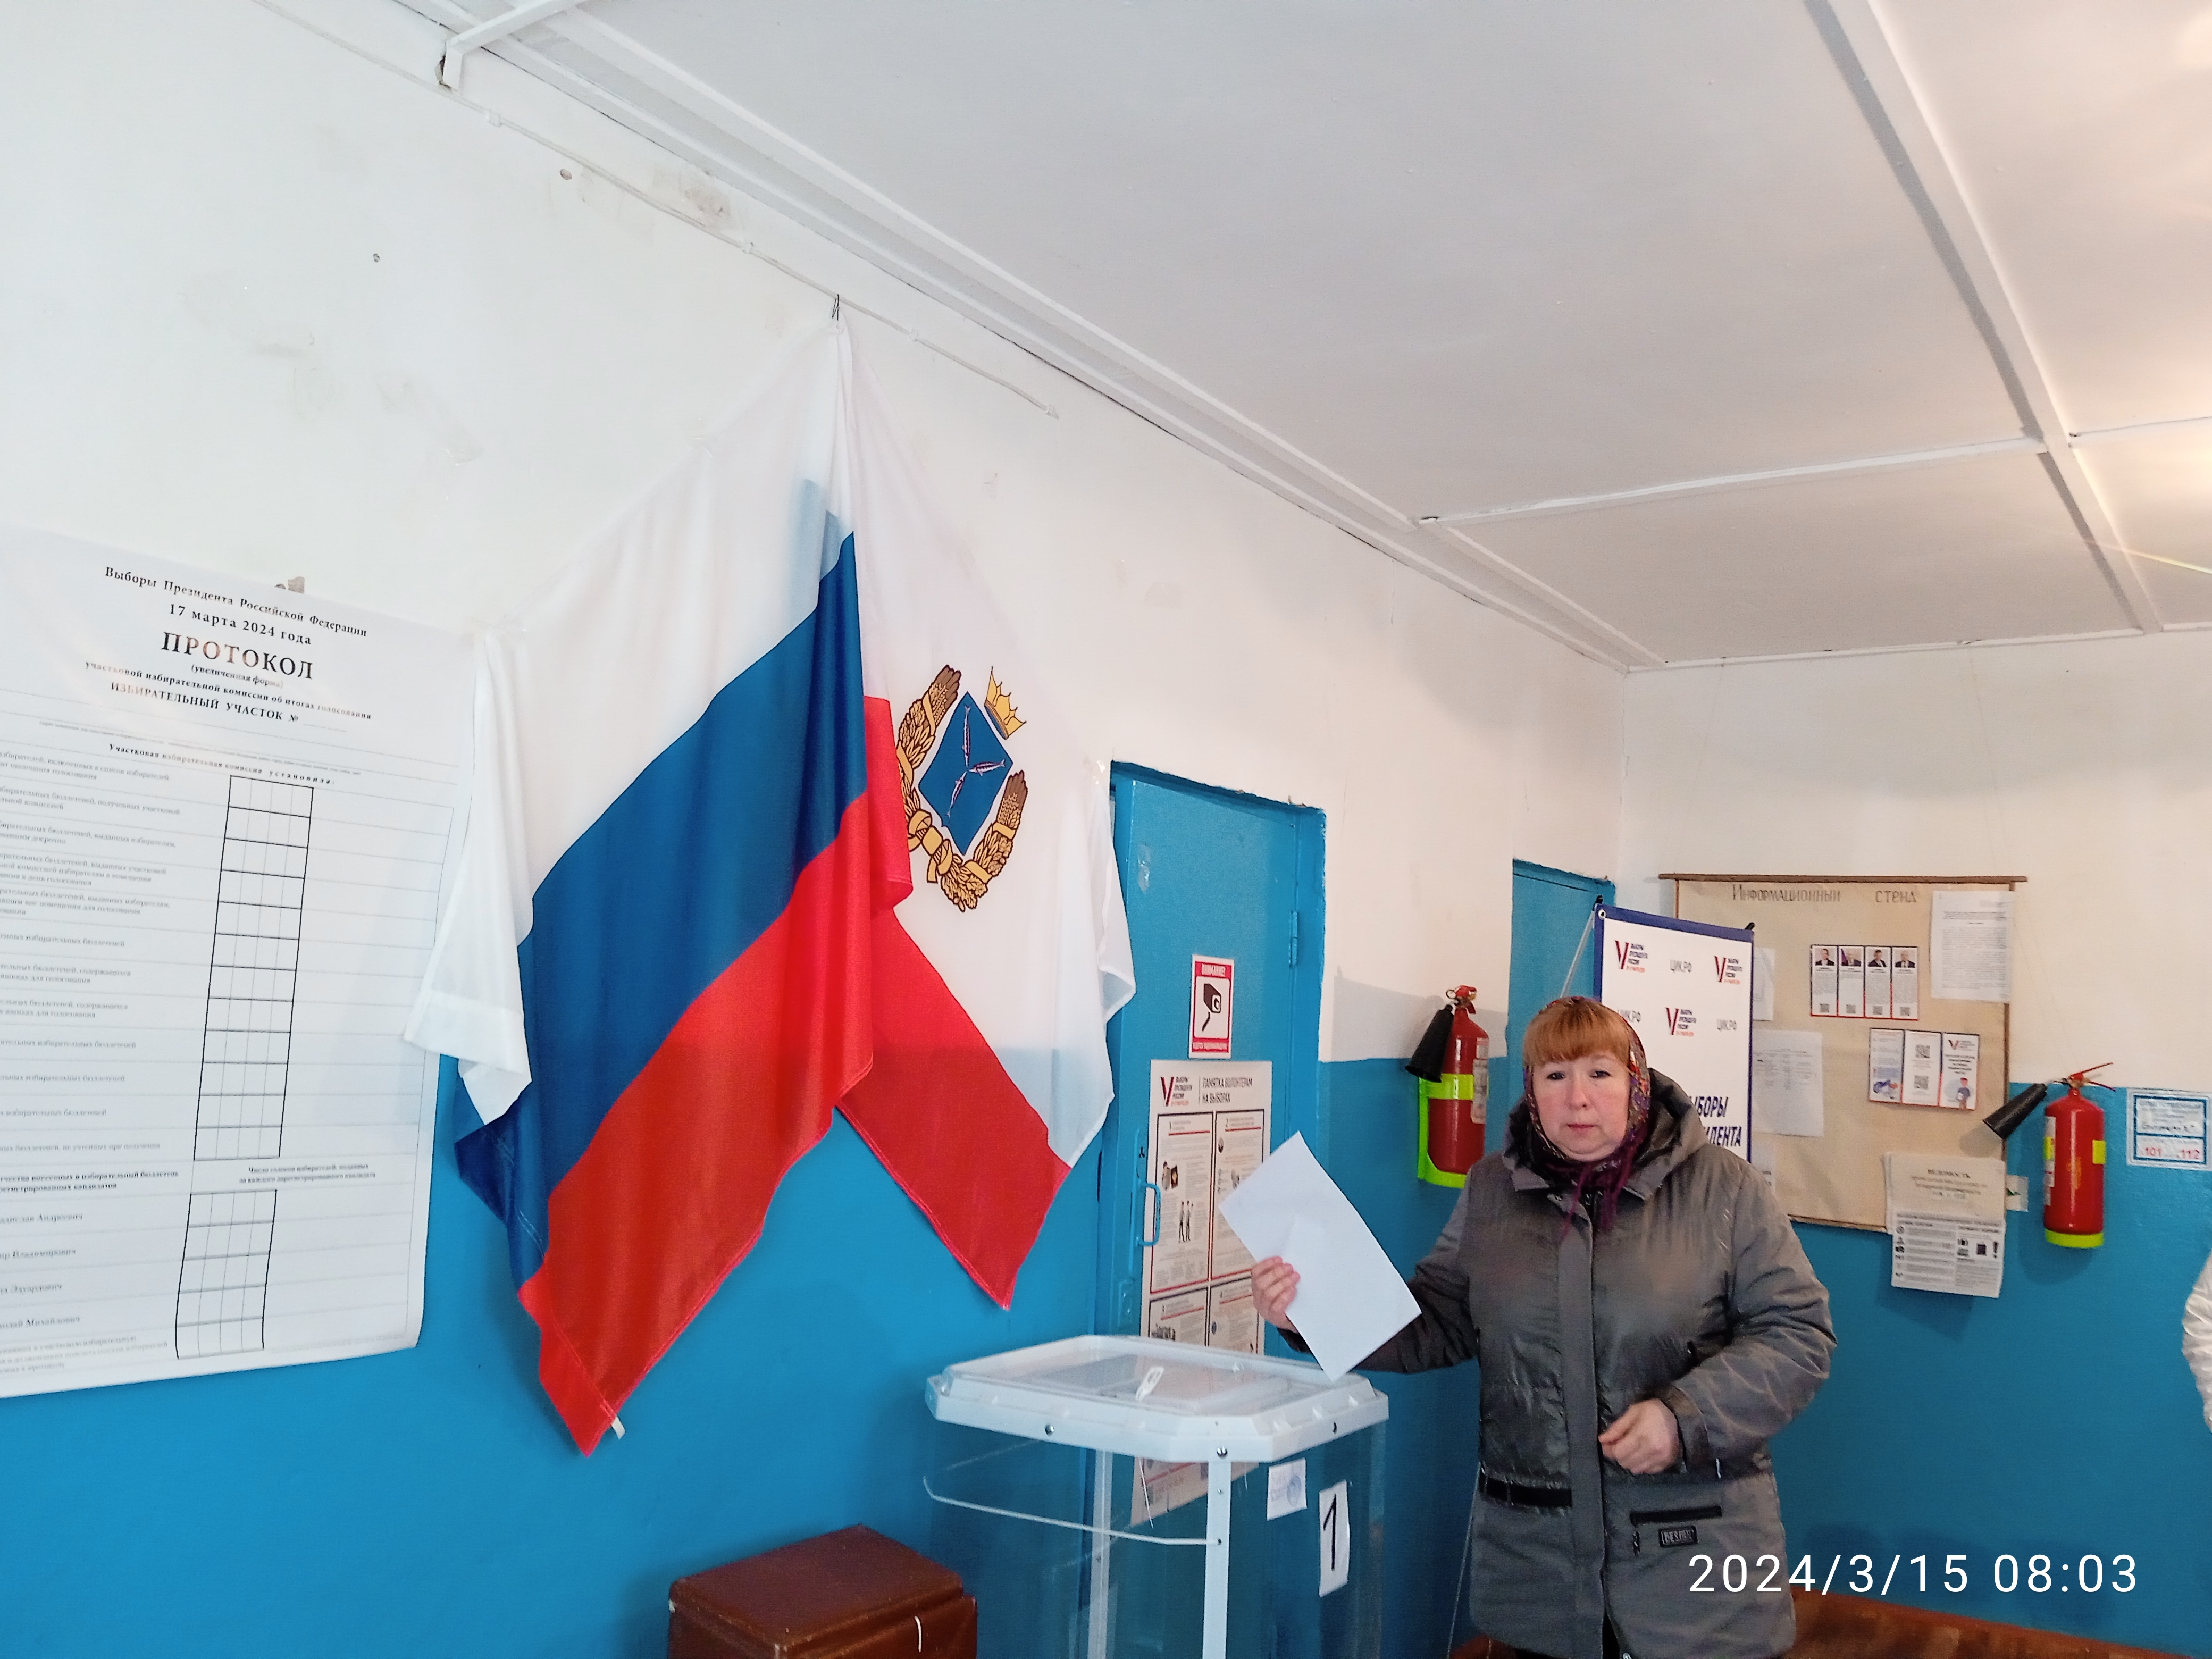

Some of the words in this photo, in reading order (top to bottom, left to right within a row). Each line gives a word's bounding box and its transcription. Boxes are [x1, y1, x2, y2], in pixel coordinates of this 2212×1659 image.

[105, 567, 157, 587] Выборы
[164, 580, 233, 605] Президента
[240, 598, 304, 622] Российской
[309, 615, 367, 636] Федерации
[170, 604, 186, 616] 17
[192, 611, 236, 627] марта
[242, 620, 275, 636] 2024
[281, 631, 311, 644] года
[161, 632, 313, 680] ПРОТОКОЛ
[85, 661, 143, 678] участковой
[146, 673, 220, 692] избирательной
[223, 687, 269, 701] комиссии
[285, 698, 315, 710] итогах
[111, 681, 219, 709] ИЗБИРАТЕЛЬНЫЙ
[225, 702, 283, 720] УЧАСТОК
[288, 714, 299, 723] №
[110, 743, 160, 758] Участковая
[1706, 1126, 1742, 1147] ДЕНТА
[1323, 1494, 1337, 1571] 1
